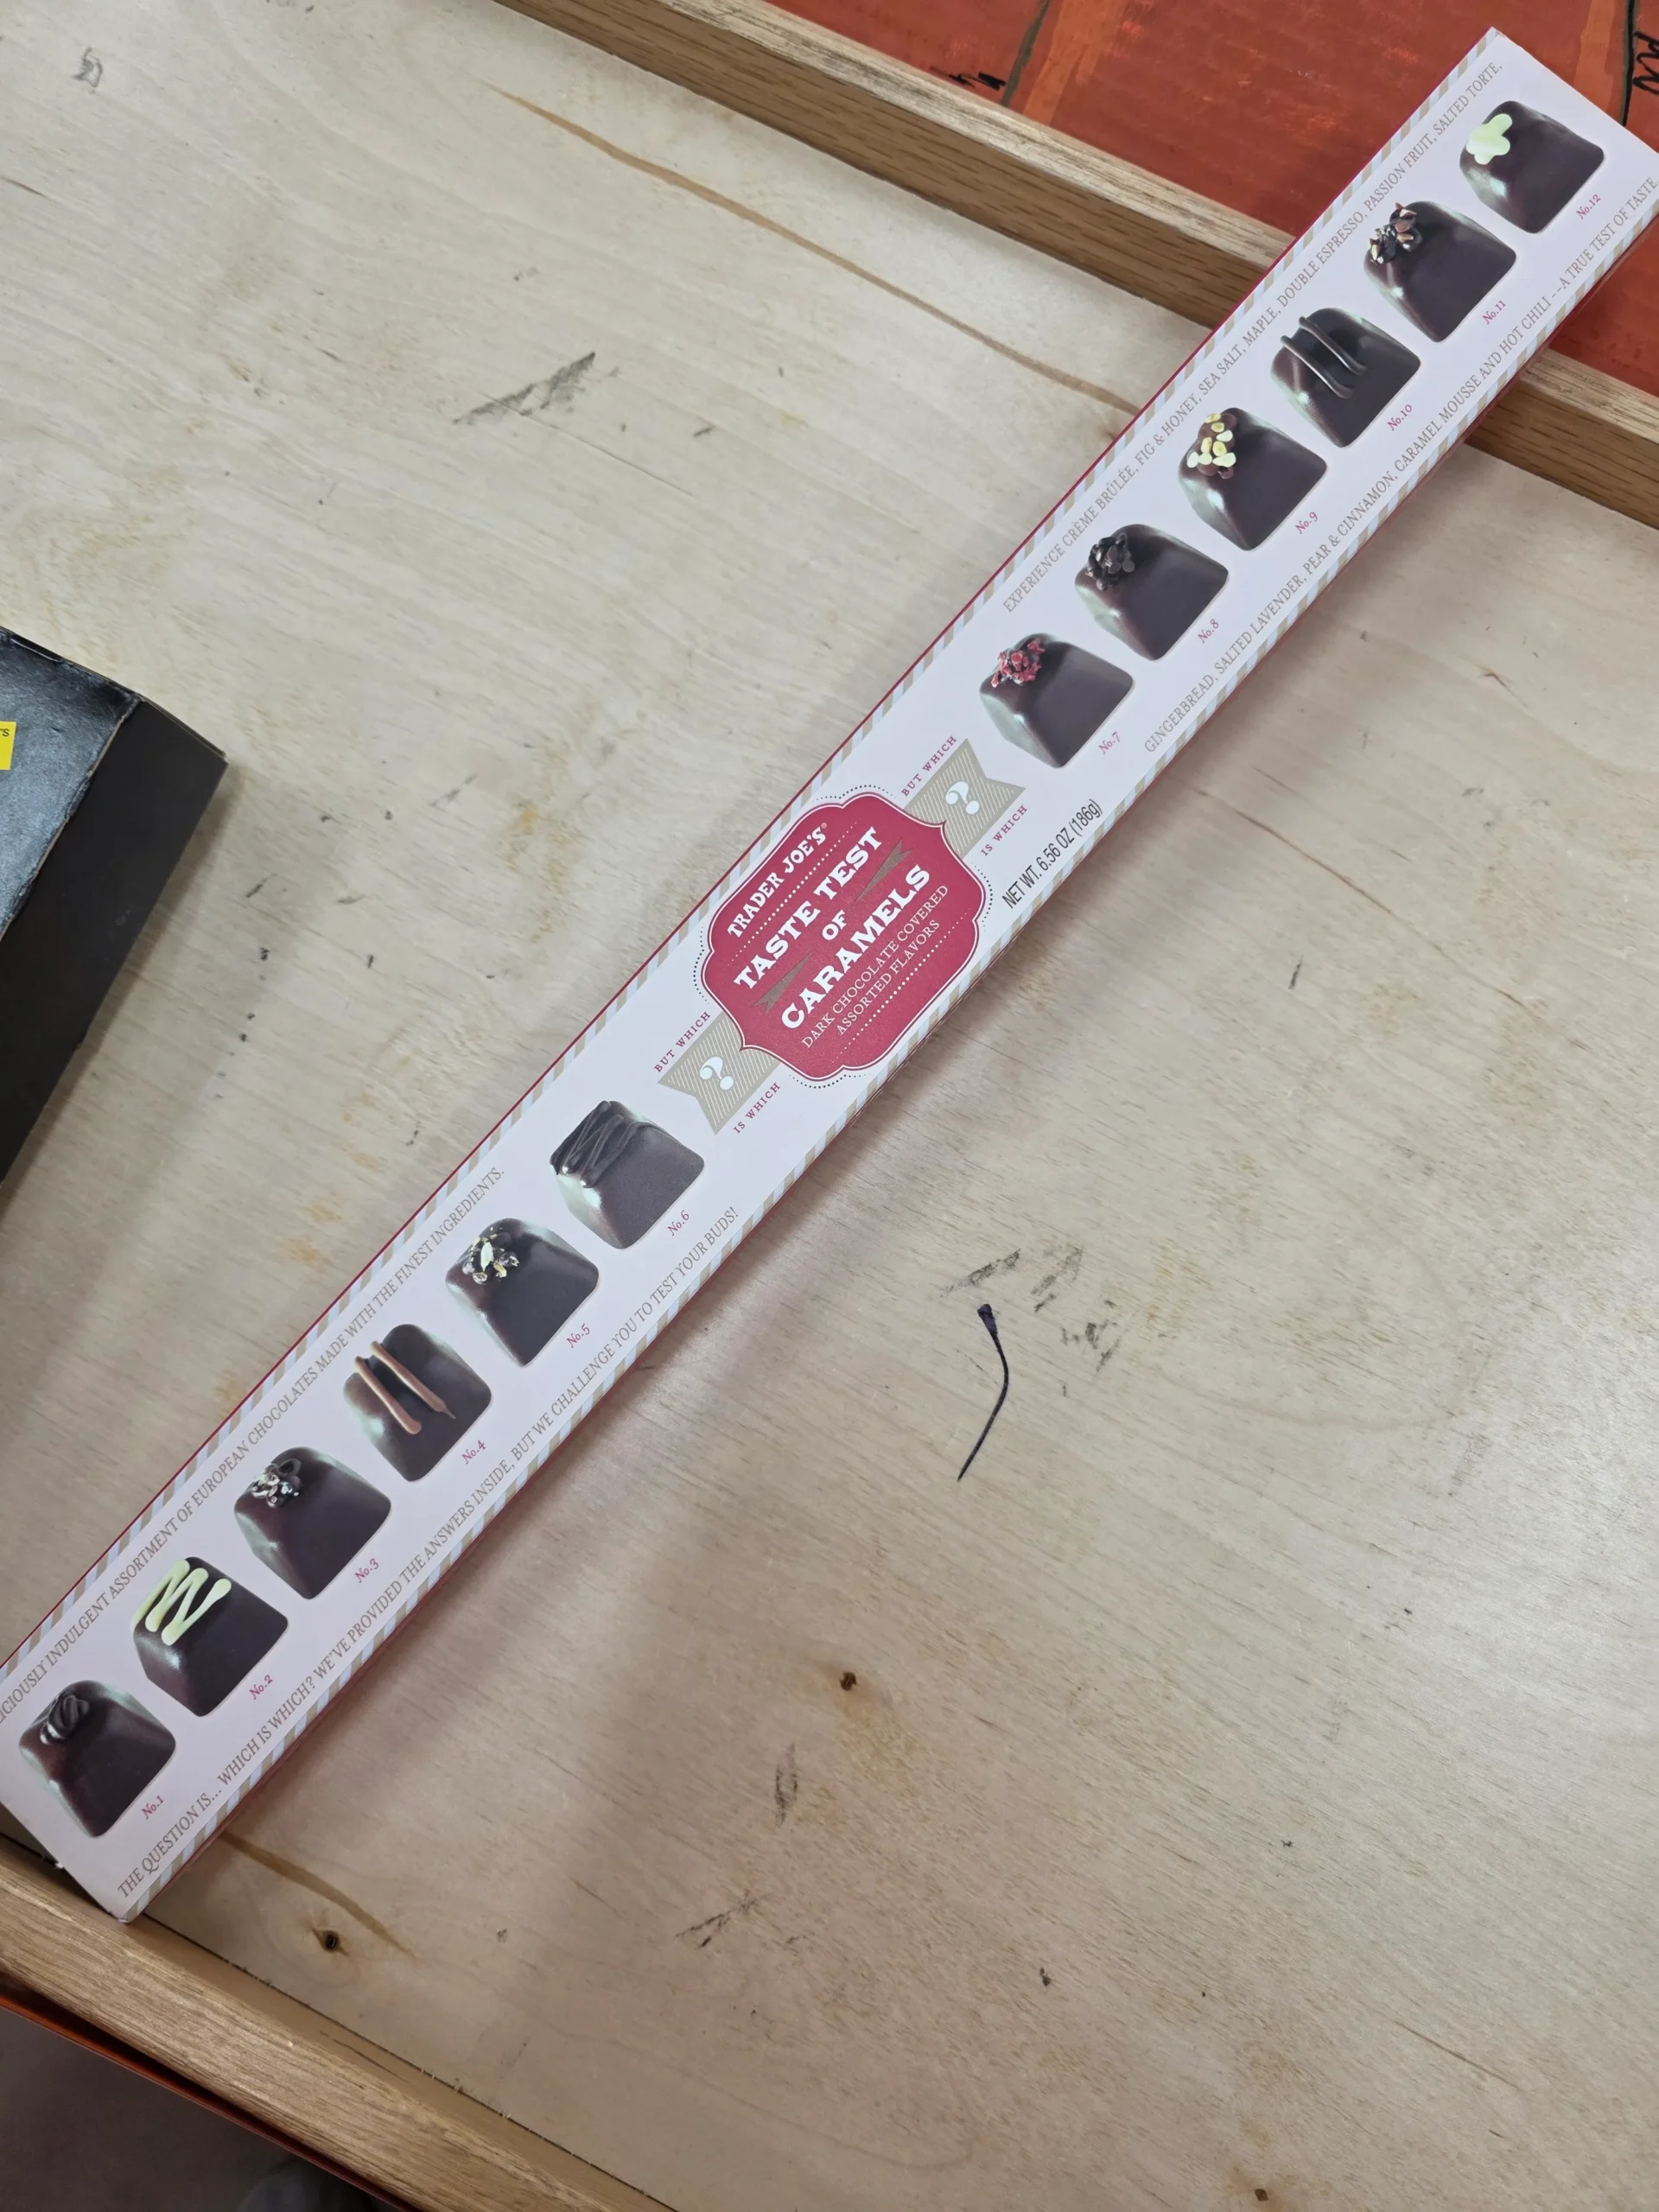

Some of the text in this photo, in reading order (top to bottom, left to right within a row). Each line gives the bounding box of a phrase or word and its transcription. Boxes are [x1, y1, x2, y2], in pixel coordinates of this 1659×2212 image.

[1574, 193, 1602, 220] No.12
[1001, 542, 1066, 613] EXPERIENCE
[1133, 442, 1156, 467] FIG
[1152, 433, 1166, 447] &
[1160, 391, 1203, 437] HONEY,
[1197, 372, 1222, 397] SEA
[1215, 342, 1247, 376] SALT,
[1241, 305, 1282, 348] MAPLE,
[1275, 259, 1321, 308] DOUBLE
[1314, 210, 1369, 266] ESPRESSO,
[1362, 162, 1407, 213] PASSION
[1402, 131, 1438, 168] FRUIT,
[1431, 94, 1470, 137] SALTED
[1464, 60, 1503, 99] TORTE,
[1480, 299, 1507, 326] No.11
[1385, 403, 1413, 432] No.10
[1143, 673, 1219, 753] GINGERBREAD,
[1213, 630, 1253, 676] SALTED
[1249, 574, 1308, 635] LAVENDER,
[1301, 543, 1332, 576] PEAR
[1326, 534, 1342, 548] &
[1336, 469, 1399, 537] CINNAMON,
[1393, 419, 1444, 473] CARAMEL
[1437, 373, 1483, 424] MOUSSE
[1478, 350, 1503, 380] AND
[1497, 324, 1524, 356] HOT
[1520, 295, 1553, 331] CHILI
[1563, 247, 1595, 280] TRUE
[1587, 221, 1617, 253] TEST
[1611, 206, 1629, 227] OF
[1294, 511, 1319, 536] No.9
[1196, 617, 1220, 645] No.8
[899, 734, 958, 798] BUT WHICH
[1097, 730, 1121, 756] No.7
[979, 803, 1029, 857] IS WHICH
[1000, 797, 1104, 910] NET WT. 6.56 OZ (186g)
[726, 870, 785, 938] TRADER
[732, 825, 883, 990] TASTE TEST
[821, 908, 848, 942] OF
[780, 862, 931, 1030] CARAMELS
[799, 884, 949, 1049] DARK CHOCOLATE COVERED
[836, 918, 940, 1037] ASSORTED FLAVORS
[652, 1009, 712, 1074] BUT WHICH
[731, 1081, 782, 1135] IS WHICH
[665, 1208, 690, 1237] No.6
[564, 1321, 591, 1350] No.5
[0, 1166, 505, 1724] ICIOUSLY INDULGENT ASSORTMENT OF EUROPEAN CHOCOLATES MADE WITH THE FINEST INGREDIENTS.
[460, 1438, 487, 1465] No.4
[116, 1866, 146, 1898] THE
[140, 1803, 200, 1877] QUESTION
[215, 1737, 261, 1786] WHICH
[255, 1724, 273, 1745] IS
[265, 1675, 316, 1730] WHICH?
[311, 1637, 353, 1680] WE'VE
[346, 1580, 403, 1645] PROVIDED
[397, 1553, 427, 1585] THE
[423, 1498, 476, 1562] ANSWERS
[469, 1458, 516, 1506] INSIDE,
[509, 1429, 537, 1462] BUT
[531, 1410, 555, 1435] WE
[550, 1342, 616, 1417] CHALLENGE
[609, 1316, 638, 1349] YOU
[632, 1300, 654, 1323] TO
[648, 1270, 678, 1306] TEST
[673, 1240, 709, 1278] YOUR
[702, 1205, 740, 1247] BUDS!
[353, 1556, 380, 1585] No.3
[248, 1673, 275, 1701] No.2
[140, 1794, 165, 1821] No.1
